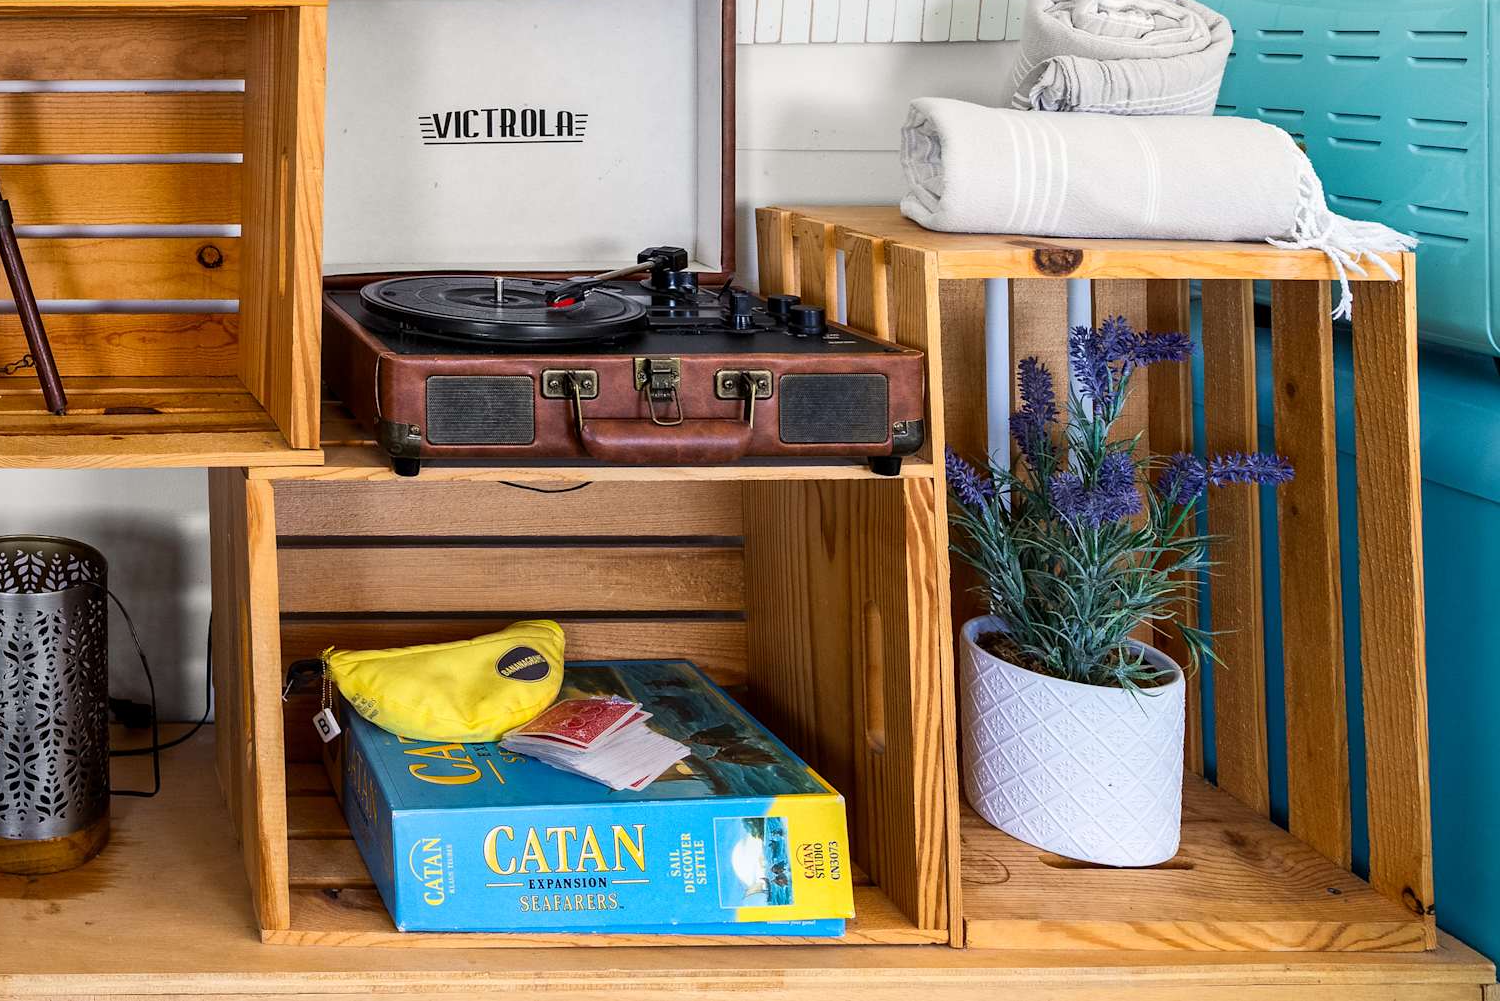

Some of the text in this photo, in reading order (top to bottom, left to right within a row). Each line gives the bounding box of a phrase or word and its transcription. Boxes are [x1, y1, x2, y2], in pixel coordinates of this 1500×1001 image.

[432, 108, 574, 139] VICTROLA
[317, 718, 331, 736] B
[483, 824, 647, 876] CATAN
[669, 848, 682, 877] SAIL
[681, 833, 696, 893] DISCOVER
[694, 839, 708, 885] SETTLE
[802, 843, 815, 879] CATAN
[813, 842, 825, 879] STUDIO
[828, 841, 841, 880] CN3073
[423, 838, 445, 906] CATAN
[529, 877, 608, 889] EXPANSION
[519, 892, 619, 913] SEAFARERS
